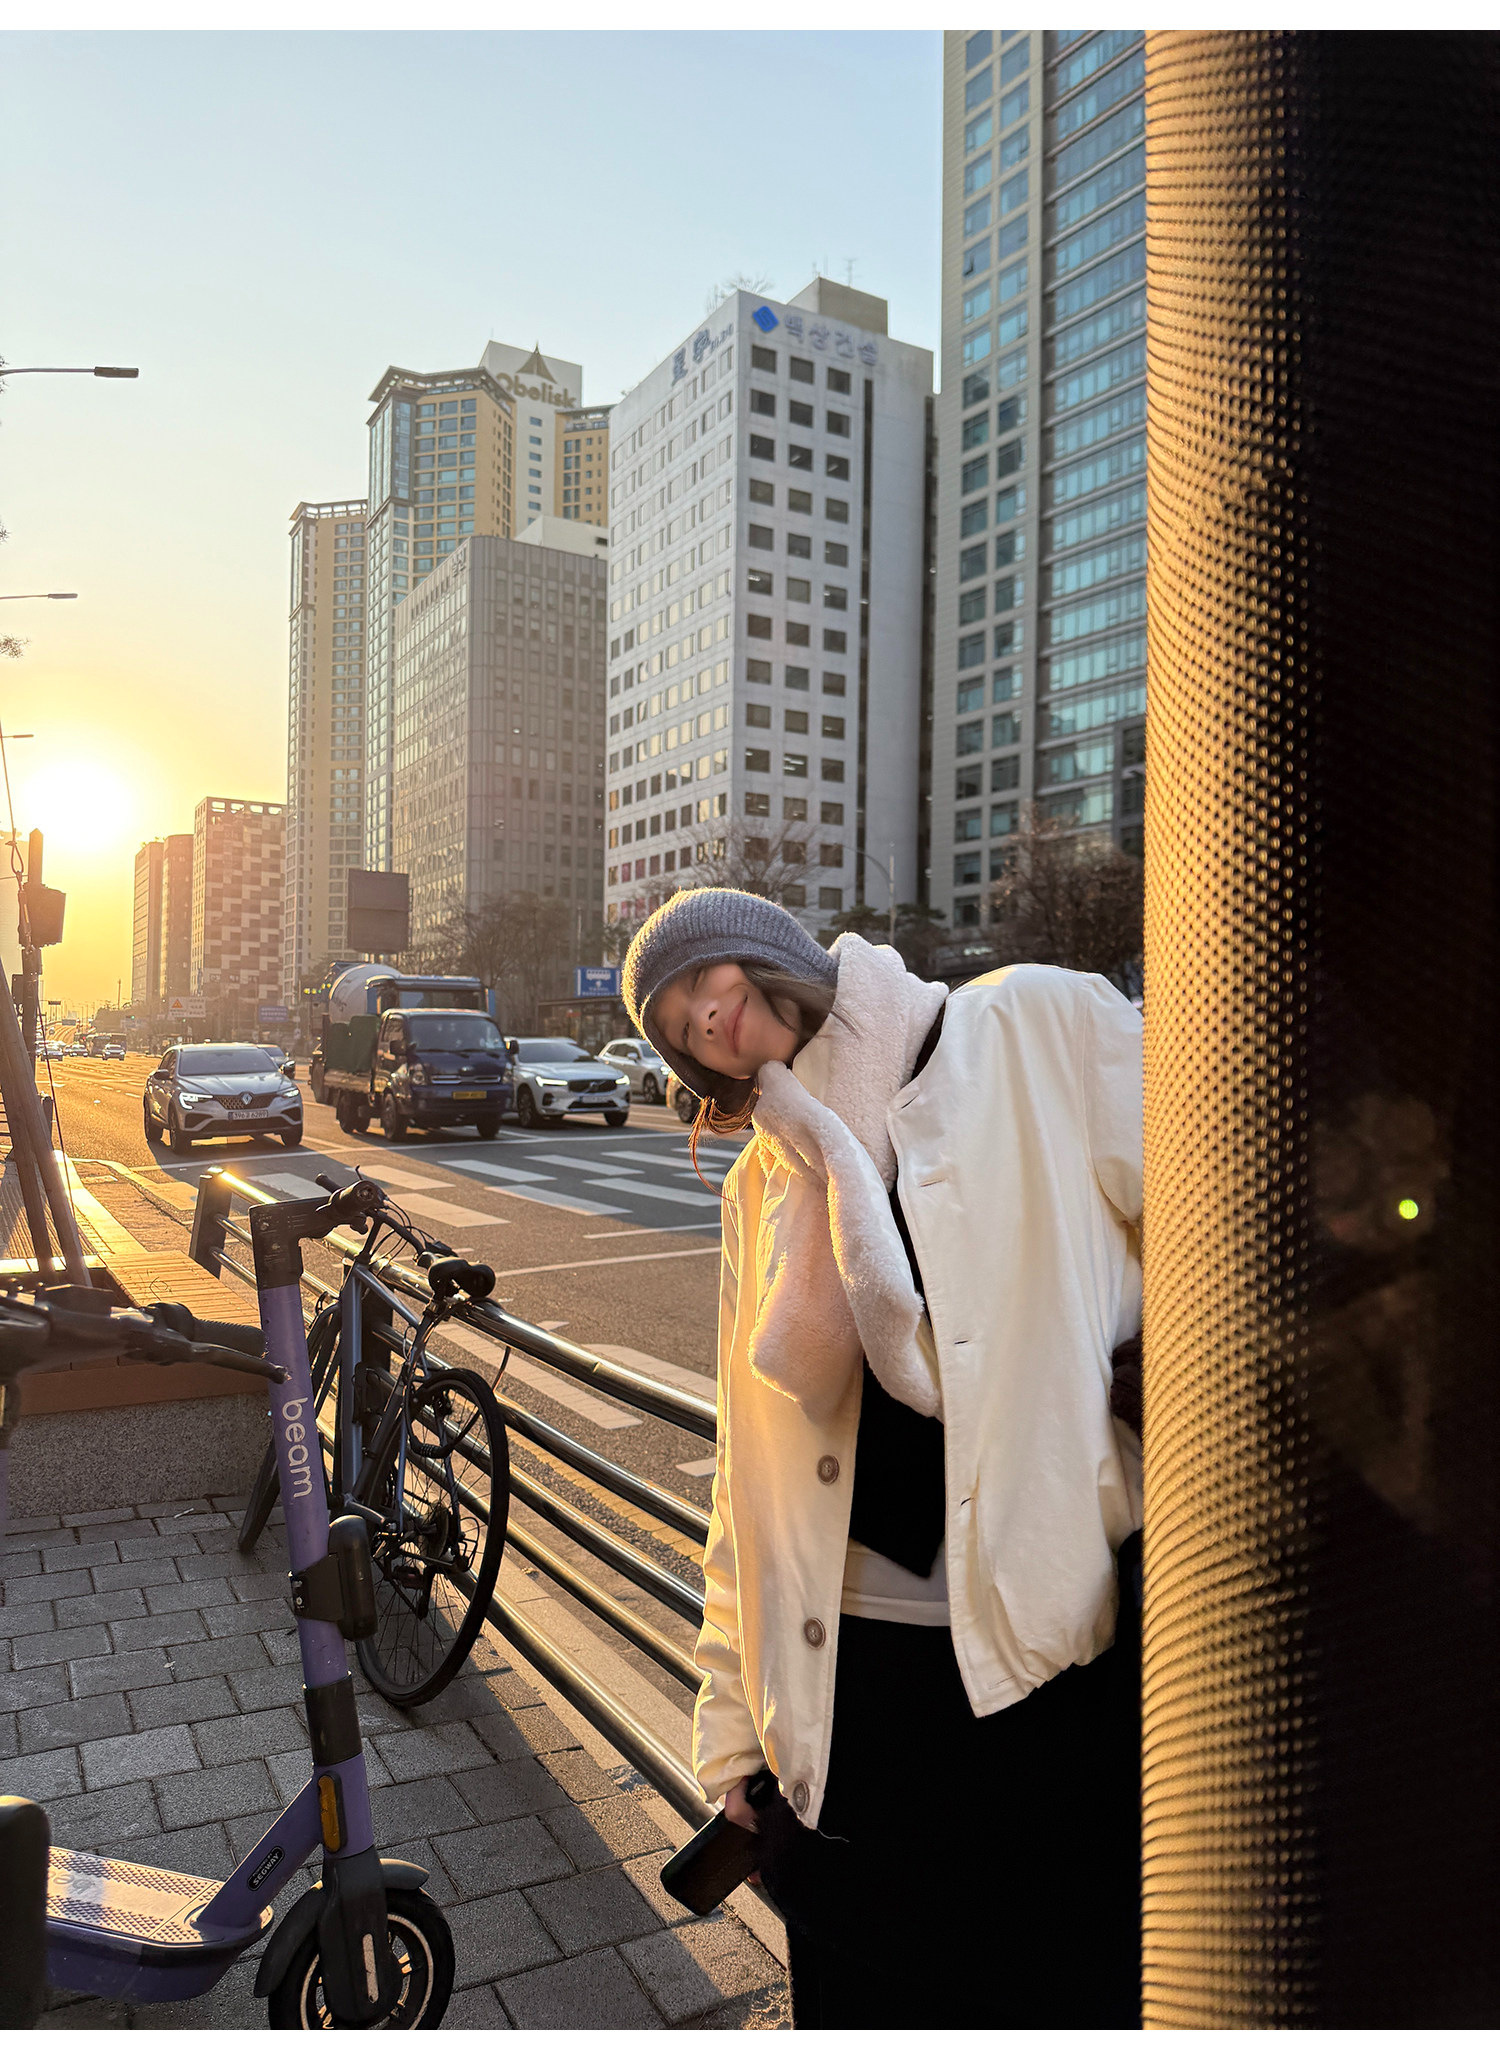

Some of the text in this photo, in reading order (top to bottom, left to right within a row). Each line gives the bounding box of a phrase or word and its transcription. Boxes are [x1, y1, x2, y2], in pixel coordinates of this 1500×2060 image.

[495, 372, 578, 409] Obelisk
[281, 1397, 313, 1498] beam
[252, 1852, 279, 1886] SEGWAY
